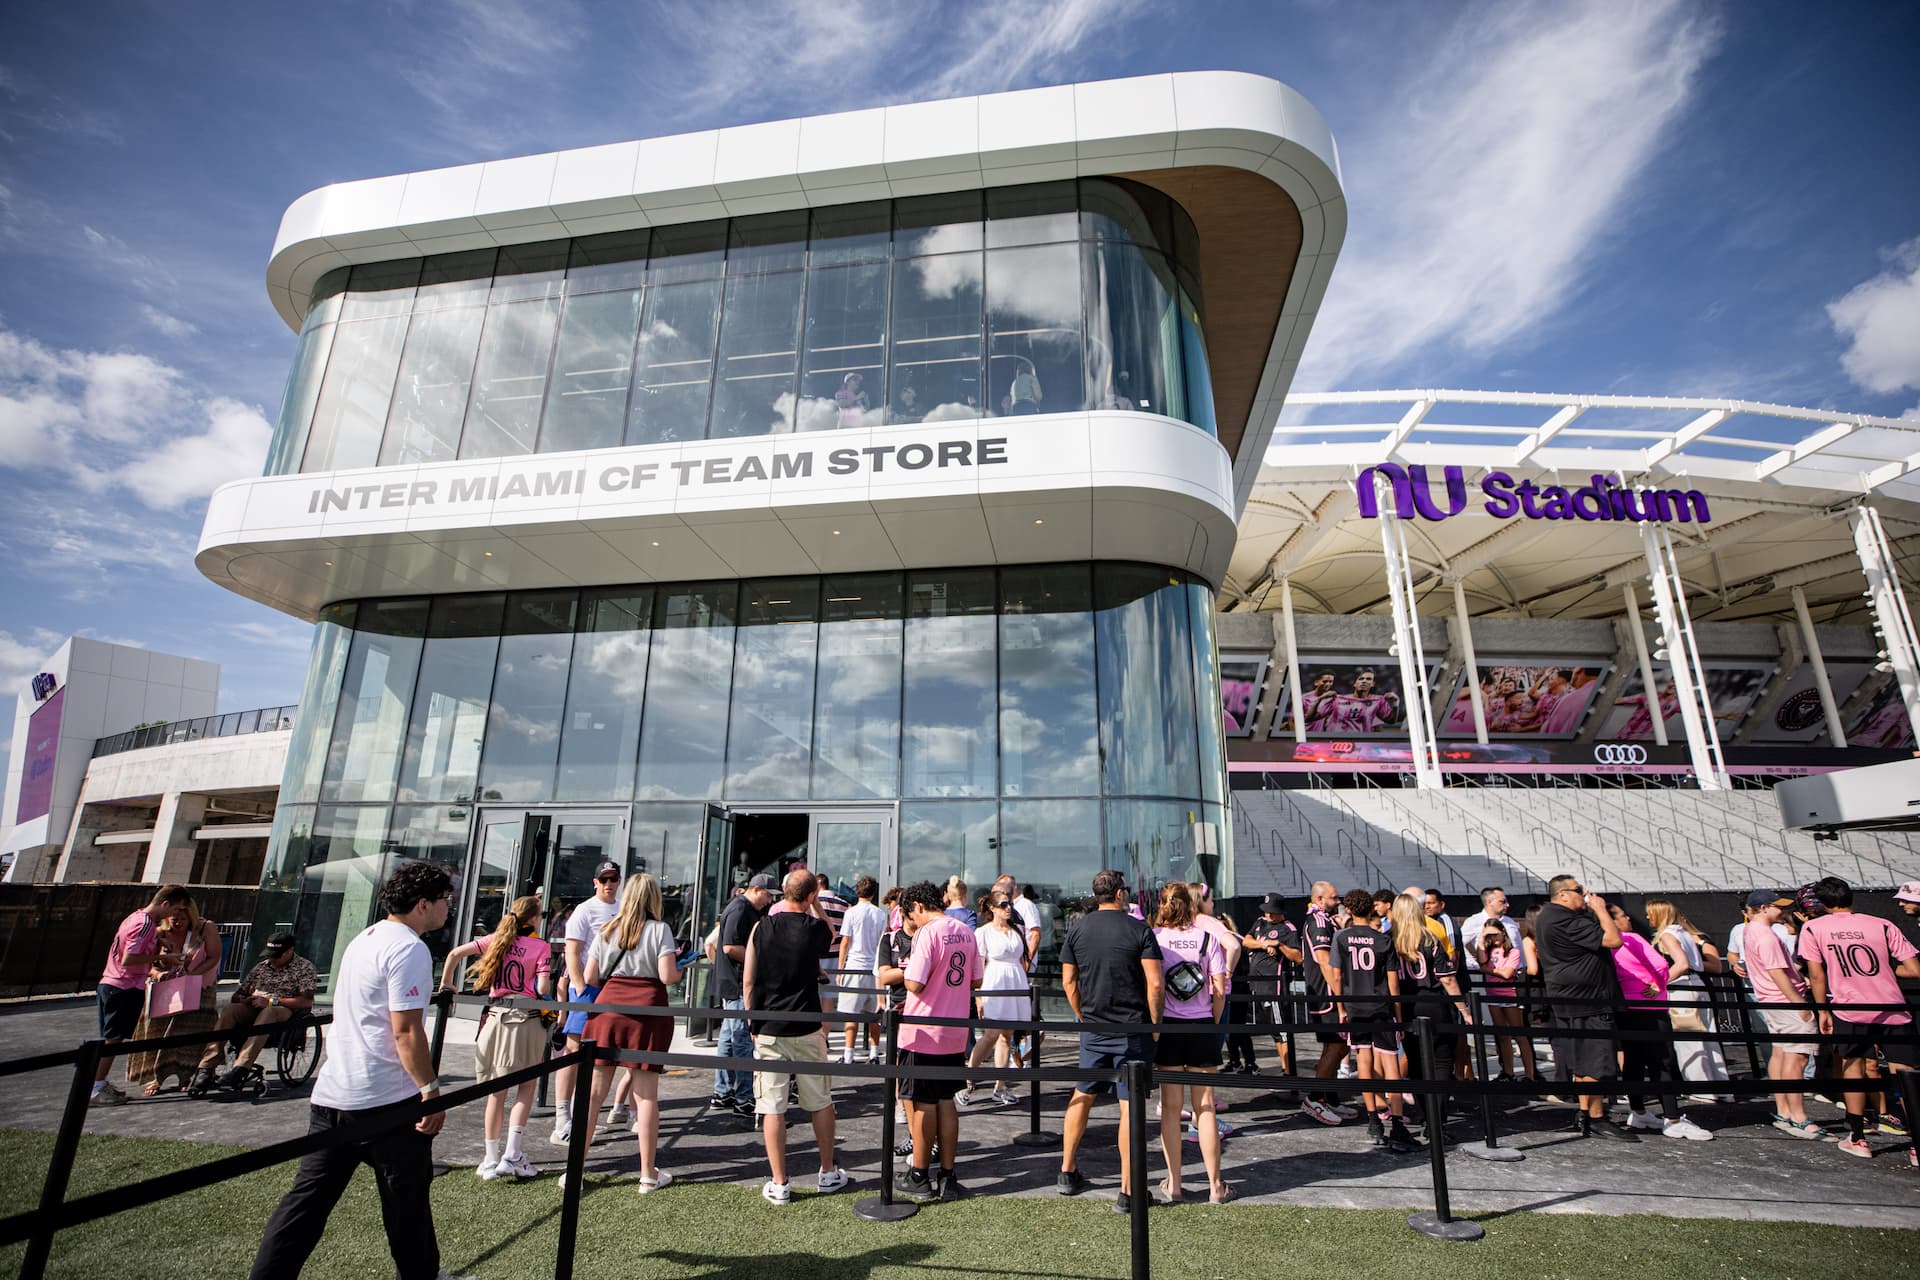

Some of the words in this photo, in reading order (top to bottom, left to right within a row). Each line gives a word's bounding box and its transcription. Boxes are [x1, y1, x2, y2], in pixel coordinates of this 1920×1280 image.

[307, 481, 437, 514] INTER
[448, 468, 584, 503] MIAMI
[598, 462, 659, 493] CF
[671, 451, 812, 487] TEAM
[827, 437, 1008, 475] STORE
[1481, 472, 1711, 522] Stadium
[1168, 940, 1198, 949] MESSI
[1830, 931, 1865, 940] MESSI
[946, 950, 967, 987] 8
[1347, 945, 1376, 971] 10
[1827, 943, 1880, 977] 10
